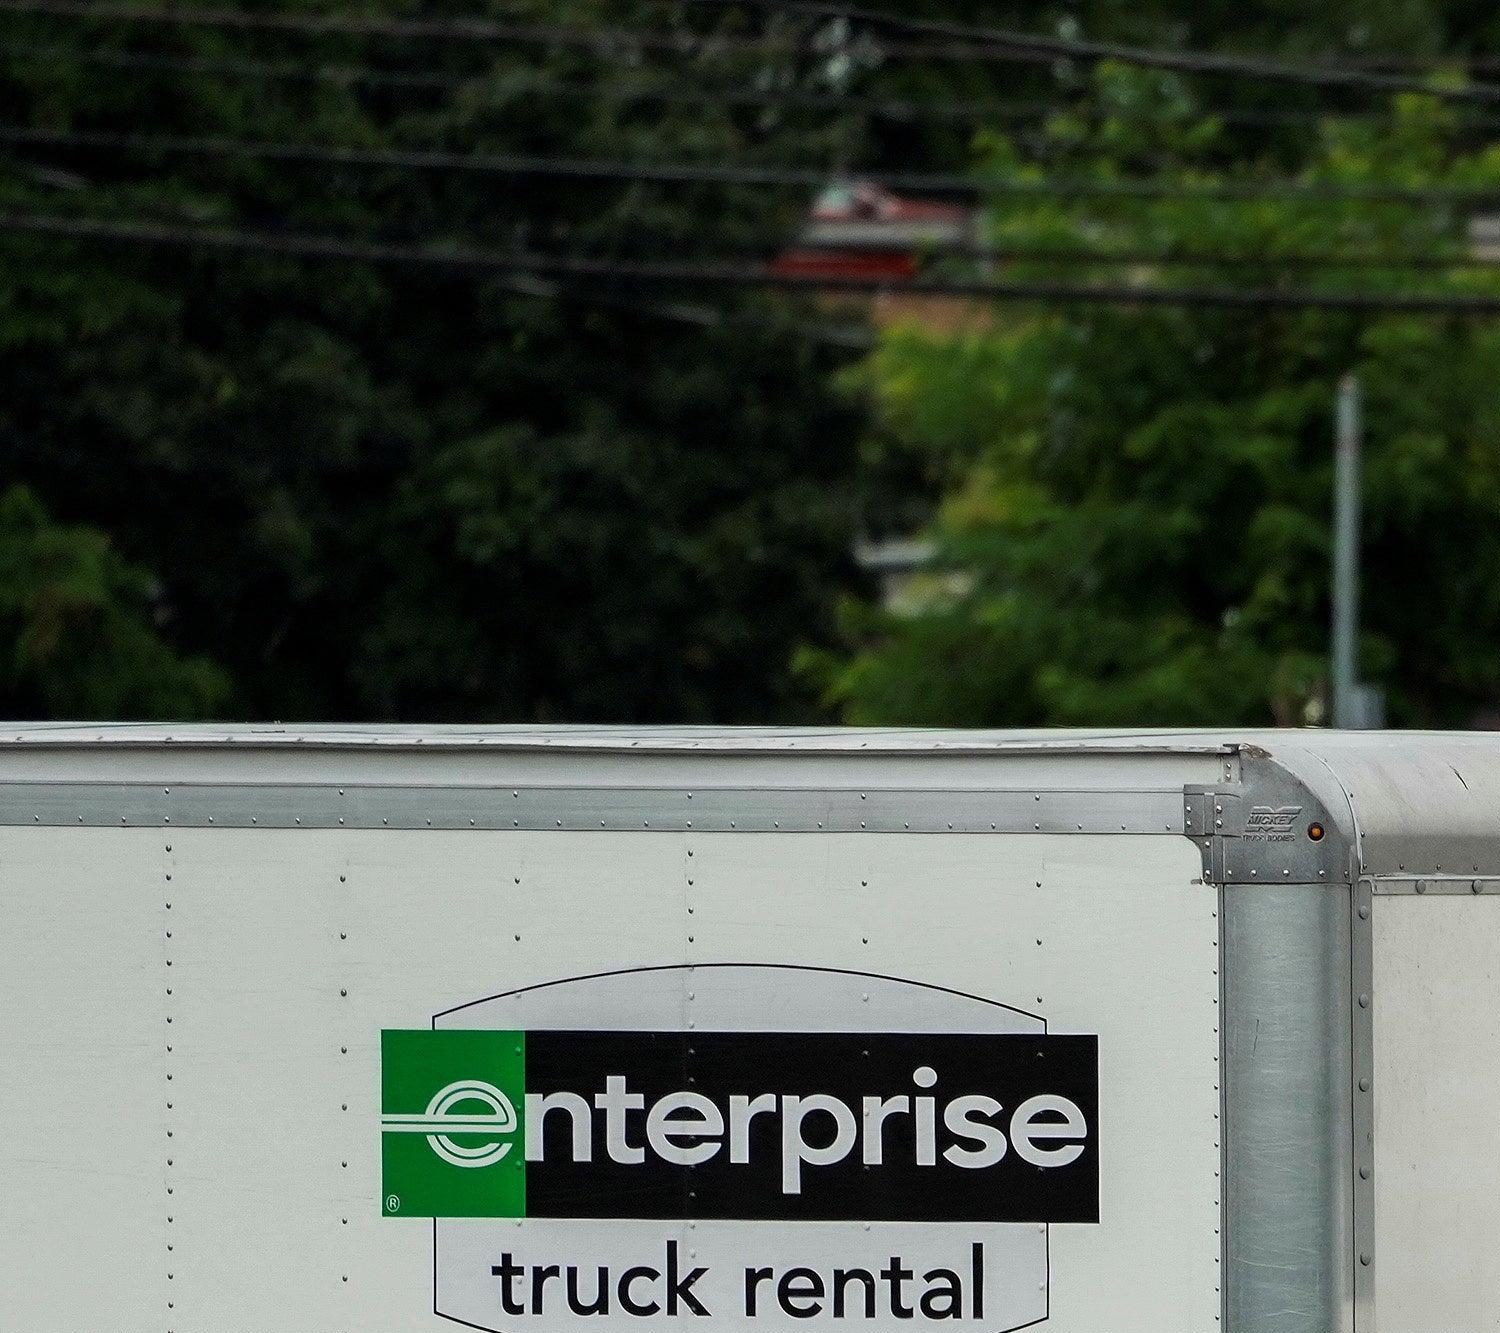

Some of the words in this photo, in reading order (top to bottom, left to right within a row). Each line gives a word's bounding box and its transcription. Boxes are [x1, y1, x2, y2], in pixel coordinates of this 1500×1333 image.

[1247, 813, 1299, 825] MICKEY
[382, 1066, 1088, 1195] enterprise
[491, 1240, 712, 1317] truck
[743, 1242, 985, 1320] rental
